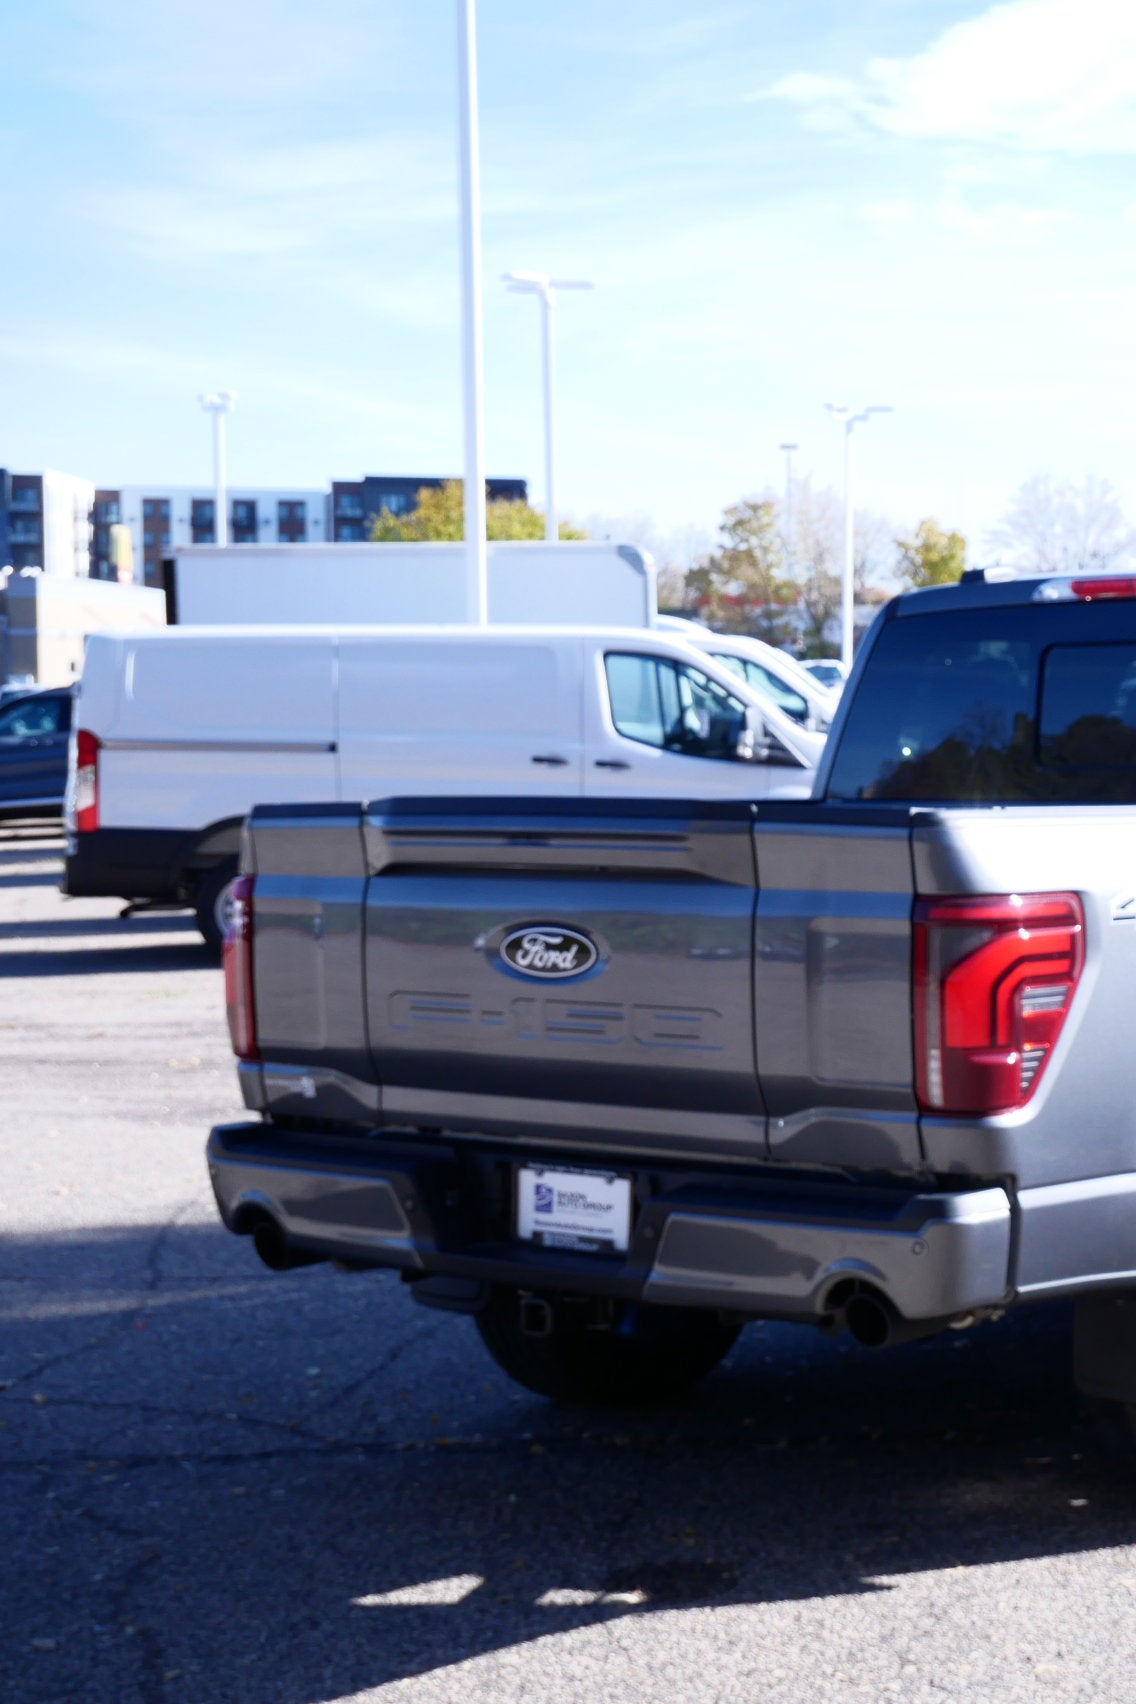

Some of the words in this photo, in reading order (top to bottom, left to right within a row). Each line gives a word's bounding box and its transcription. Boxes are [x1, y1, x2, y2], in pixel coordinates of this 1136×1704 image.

[514, 932, 578, 971] Ford
[388, 989, 724, 1051] F-150
[583, 1202, 614, 1213] GROUP
